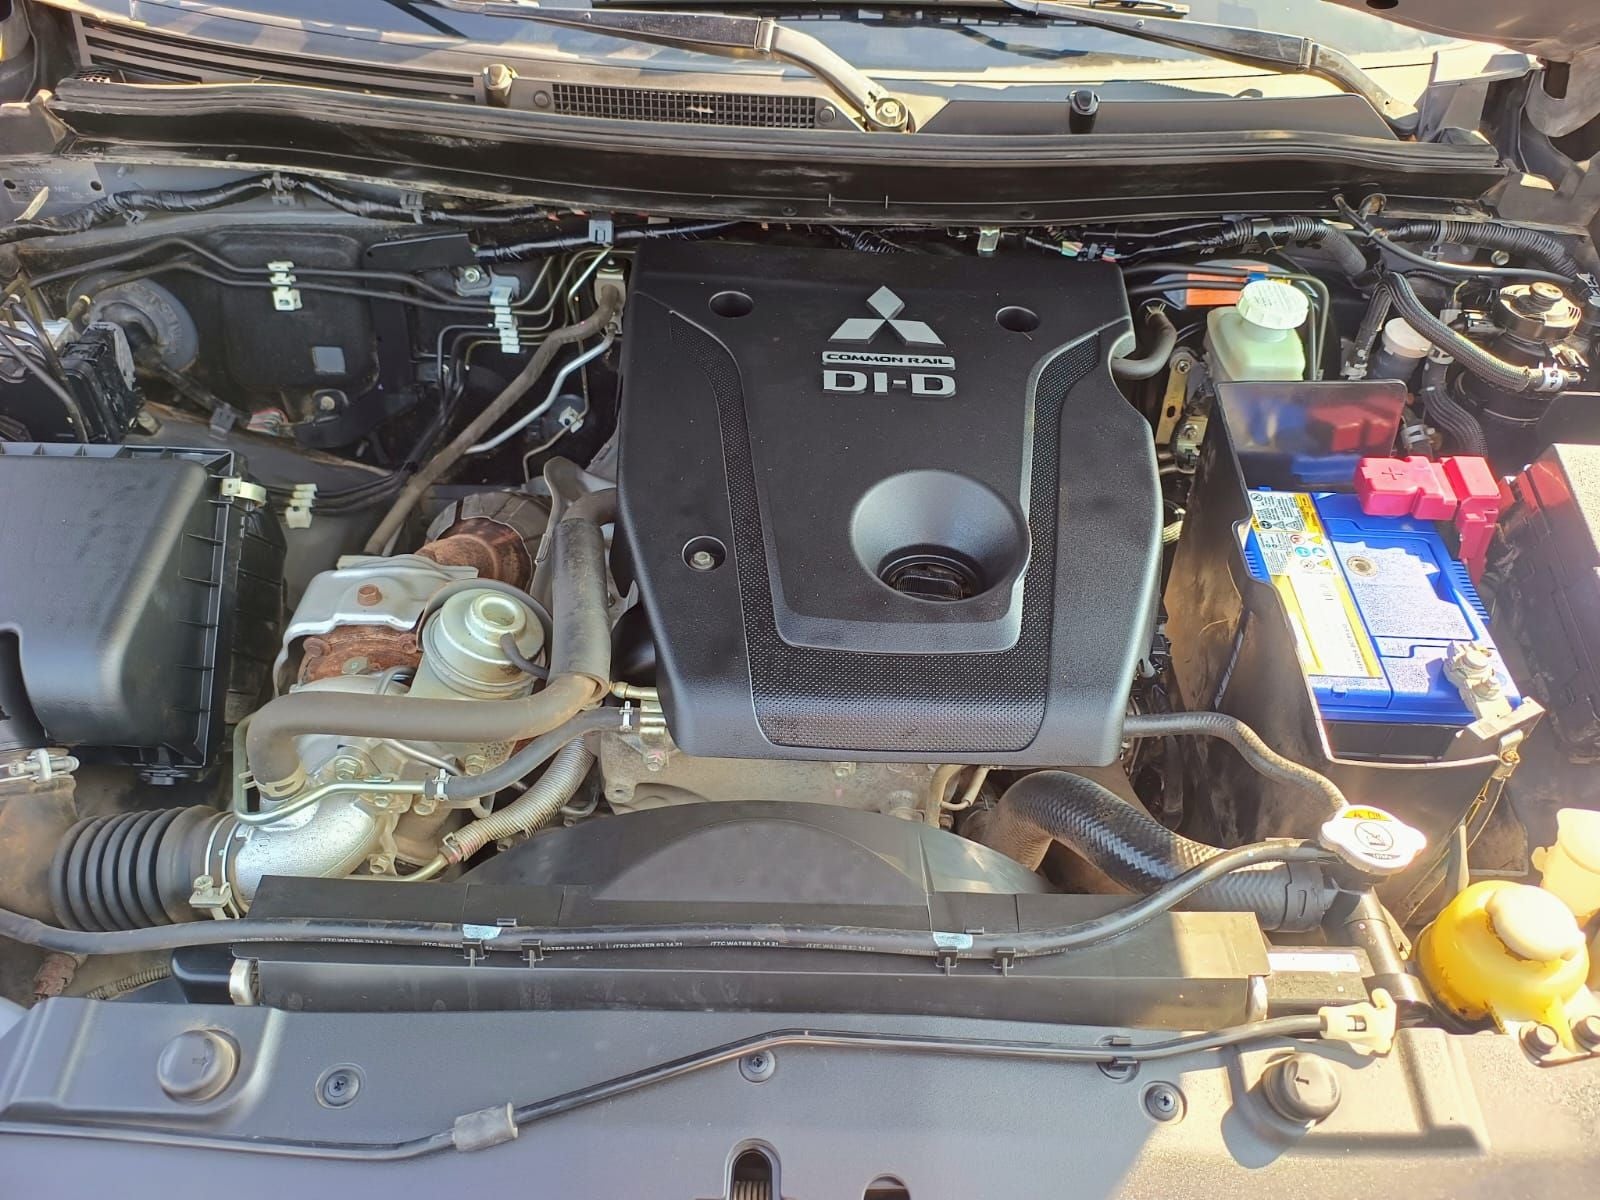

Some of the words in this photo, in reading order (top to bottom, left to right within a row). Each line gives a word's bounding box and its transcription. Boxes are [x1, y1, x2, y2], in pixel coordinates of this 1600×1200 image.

[826, 353, 904, 364] COMMON
[907, 357, 951, 365] RAIL
[822, 369, 956, 397] DI-D
